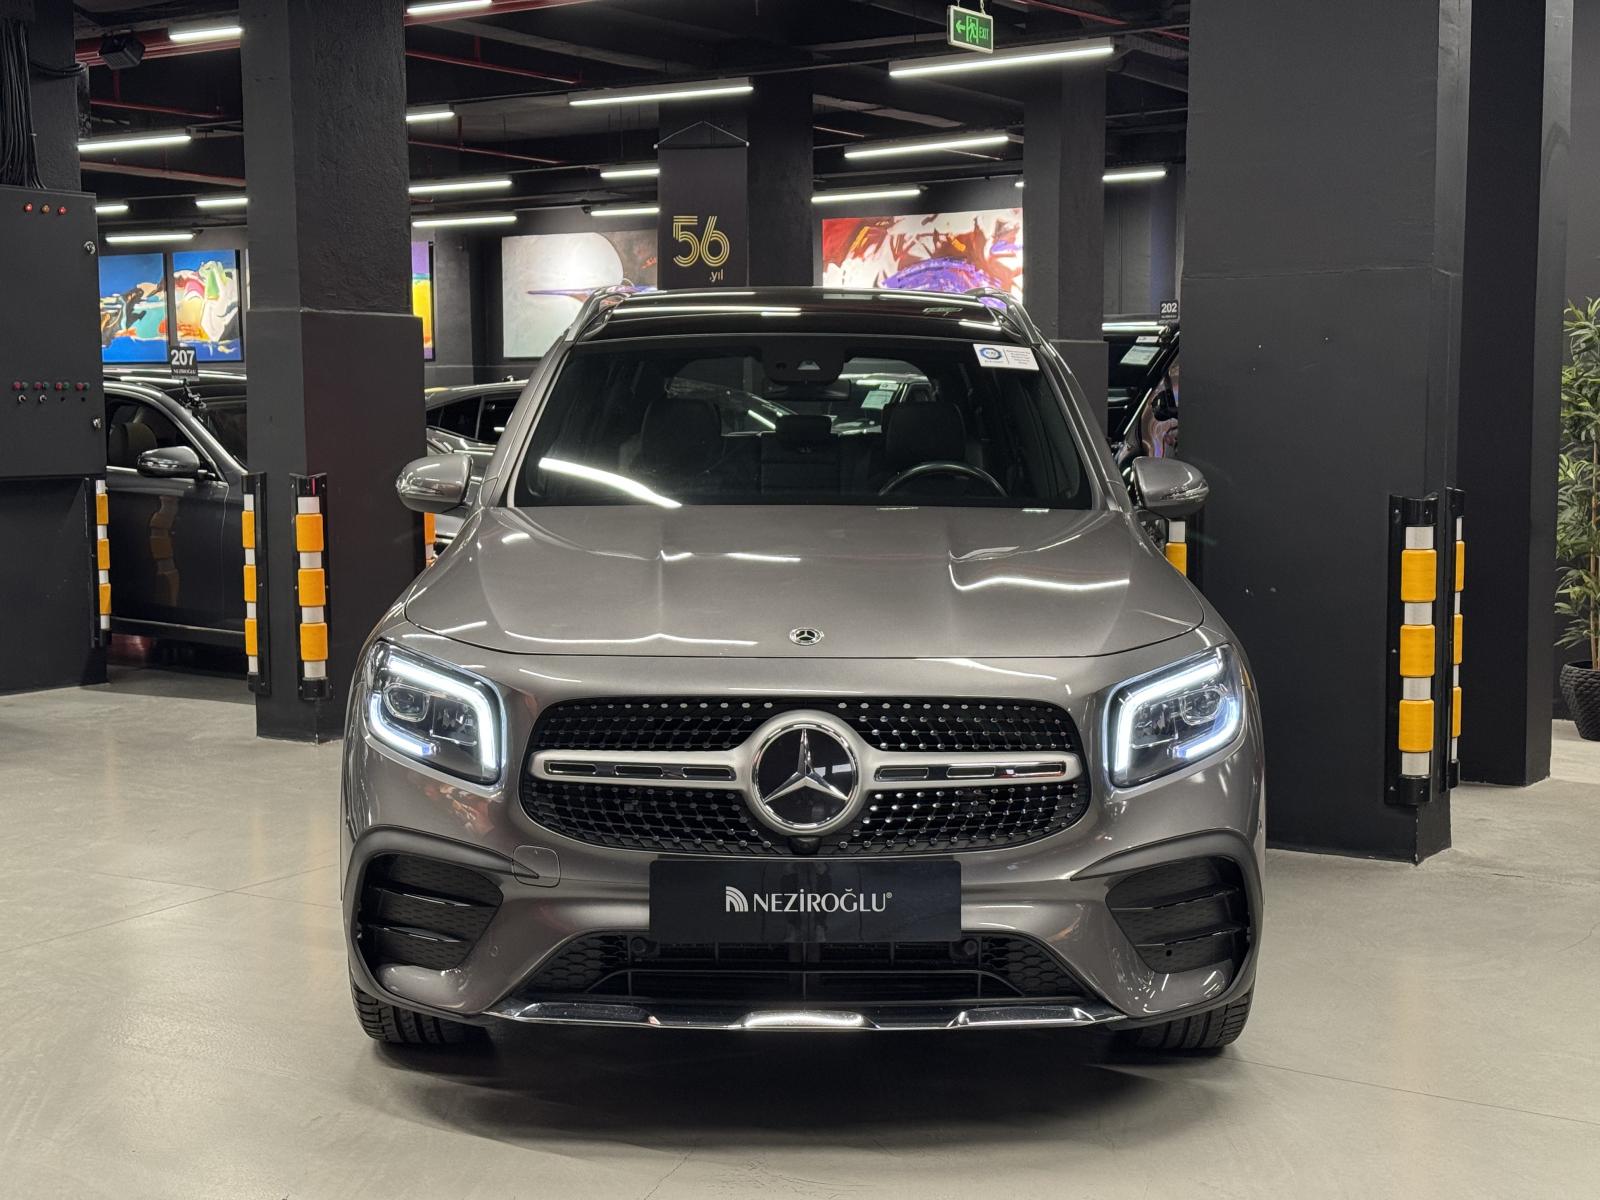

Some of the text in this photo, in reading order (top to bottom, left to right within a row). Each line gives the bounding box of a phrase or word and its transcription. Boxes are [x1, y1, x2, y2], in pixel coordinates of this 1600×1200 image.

[979, 26, 989, 40] EXIT
[673, 215, 730, 267] 56
[1161, 302, 1178, 314] 202
[170, 350, 195, 366] 207
